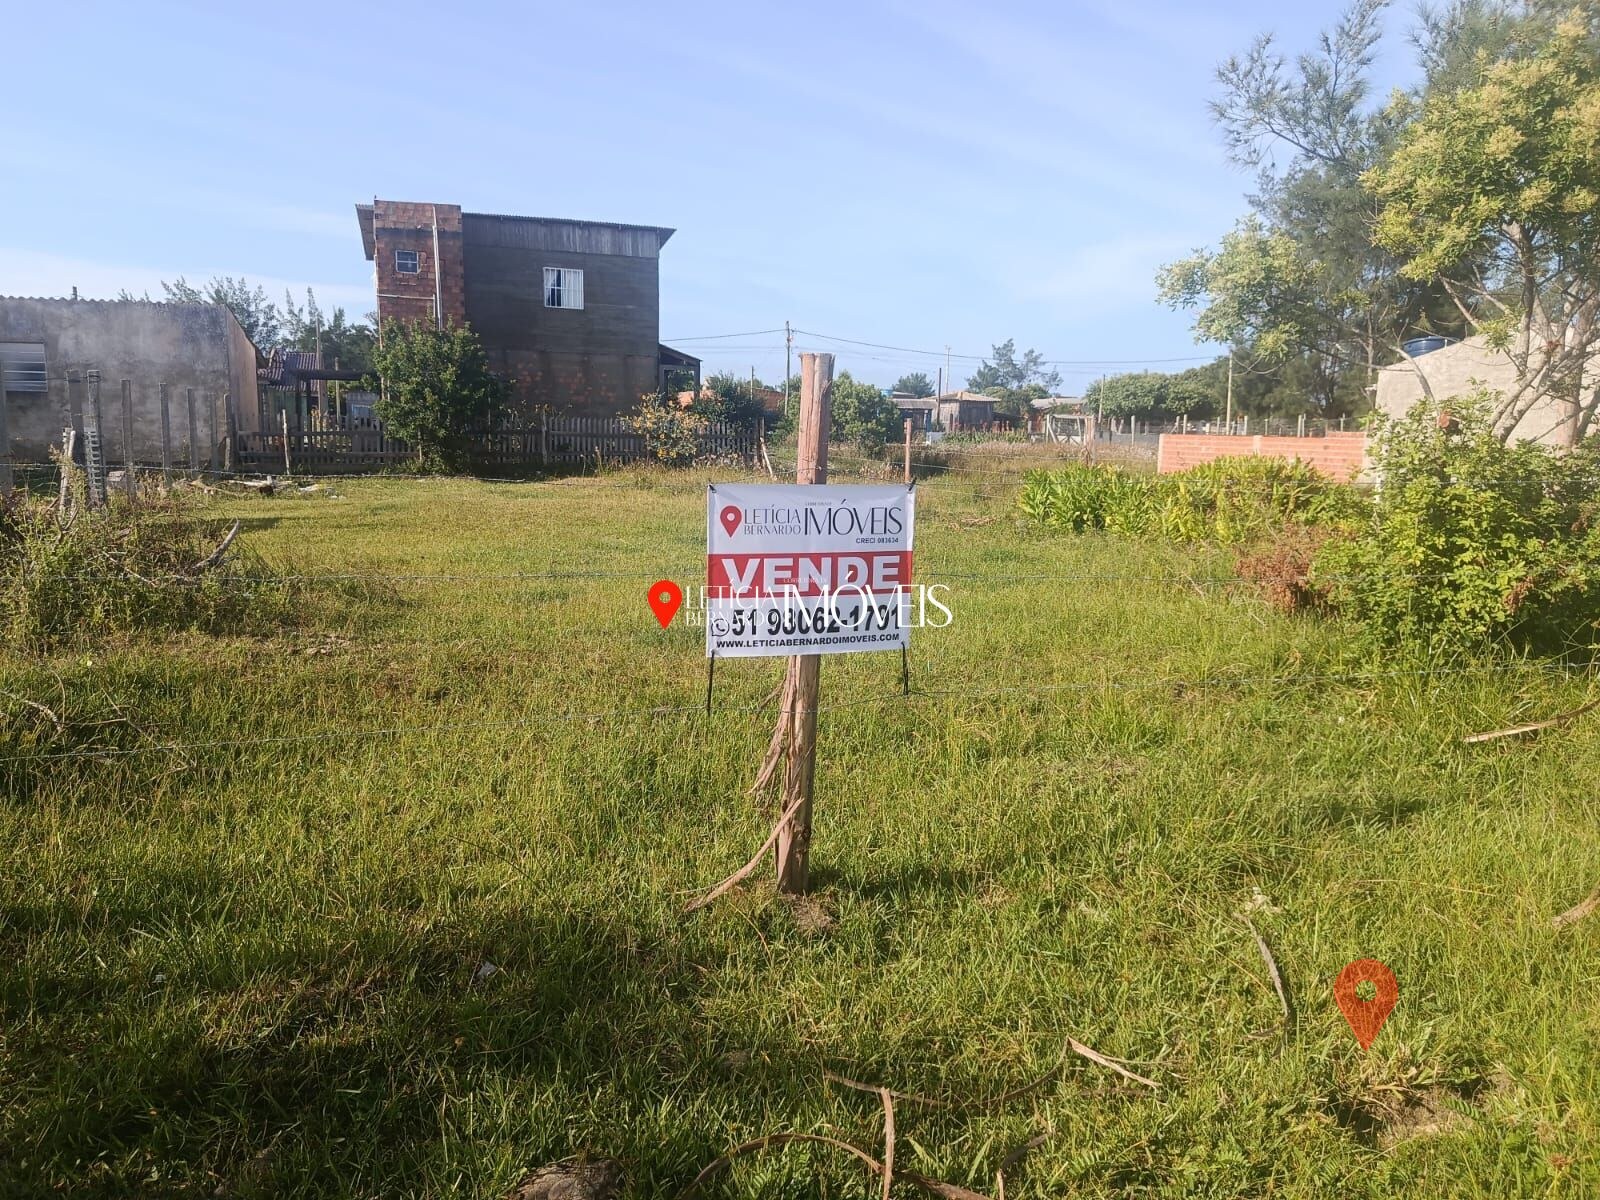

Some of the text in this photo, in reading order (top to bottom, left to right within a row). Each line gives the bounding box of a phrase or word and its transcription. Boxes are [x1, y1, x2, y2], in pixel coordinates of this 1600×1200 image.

[744, 504, 801, 524] LETÍCIA
[805, 499, 902, 536] IMÓVEIS
[744, 525, 801, 536] BERNARDO
[721, 555, 900, 593] VENDE
[732, 608, 758, 636] 51
[716, 632, 900, 649] WWW.LETICIABERNARDOIMOVEIS.COM
